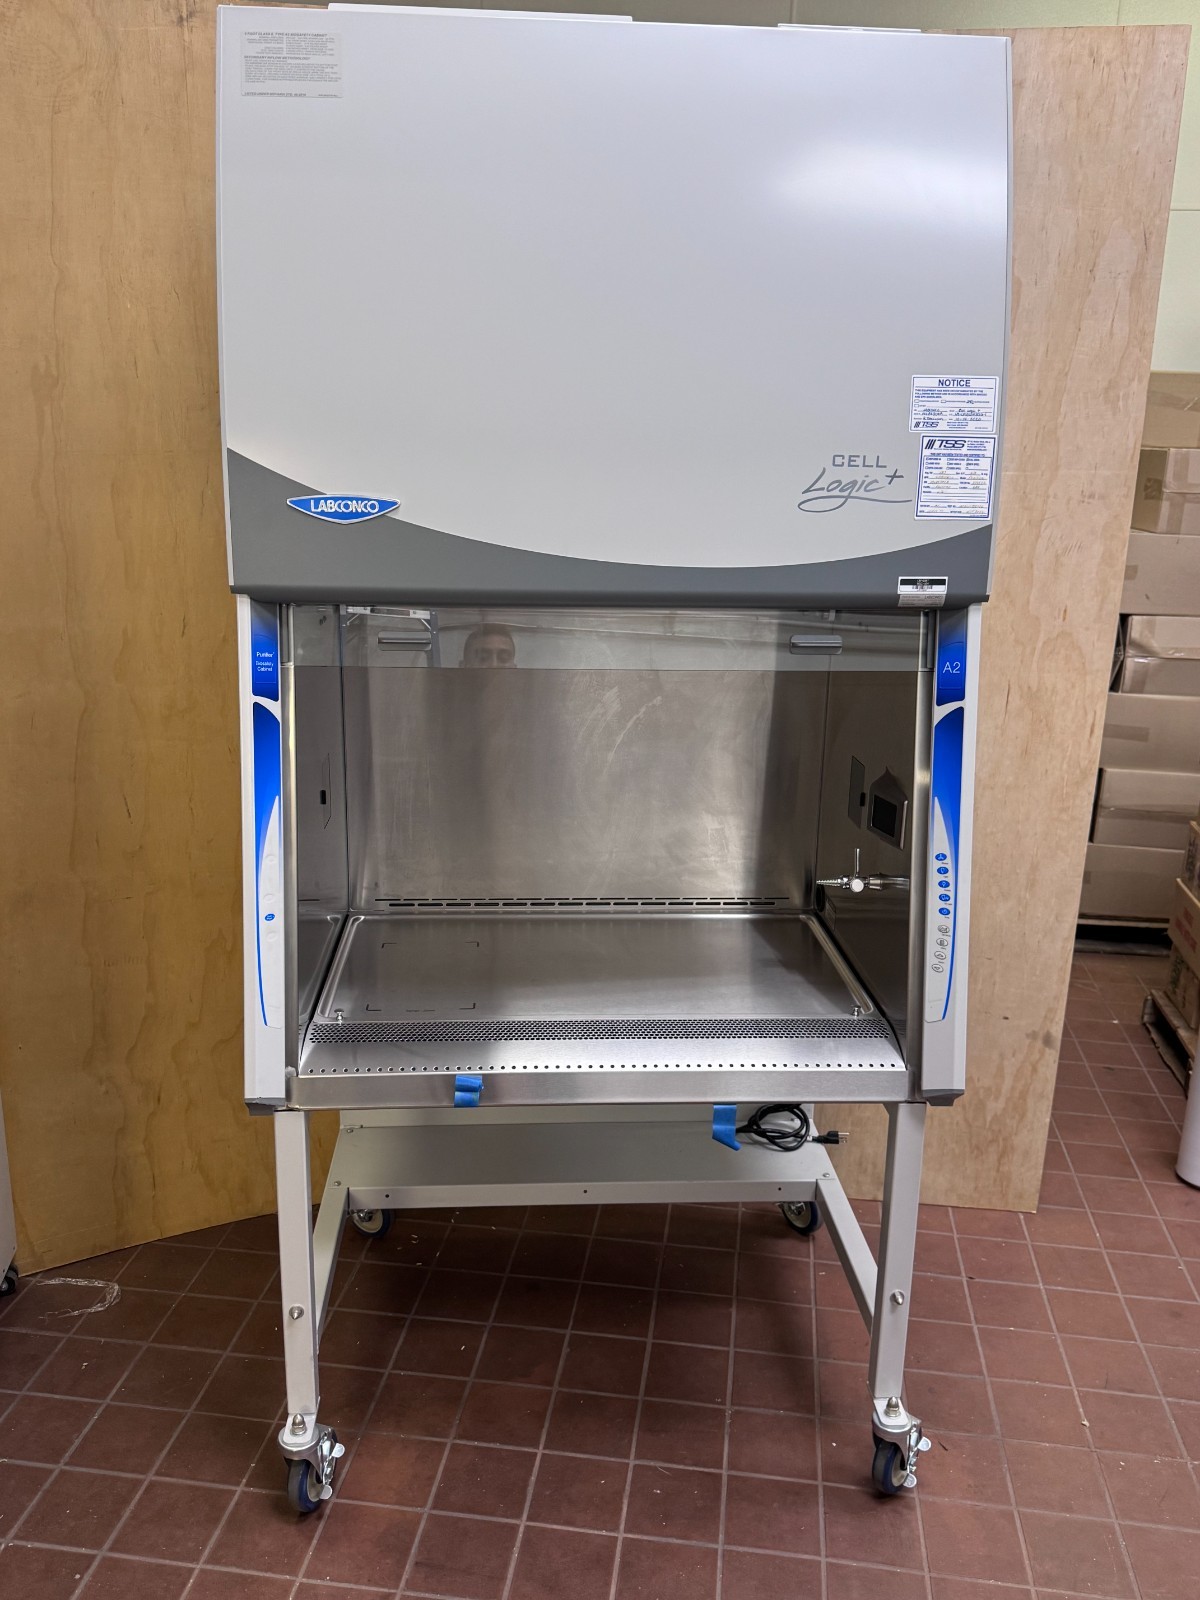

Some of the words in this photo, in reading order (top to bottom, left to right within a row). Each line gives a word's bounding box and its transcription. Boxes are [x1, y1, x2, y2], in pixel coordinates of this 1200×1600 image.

[938, 379, 971, 387] NOTICE
[936, 439, 967, 449] TSS
[832, 454, 887, 468] CELL
[310, 499, 379, 513] LABCONCO
[942, 661, 961, 674] A2
